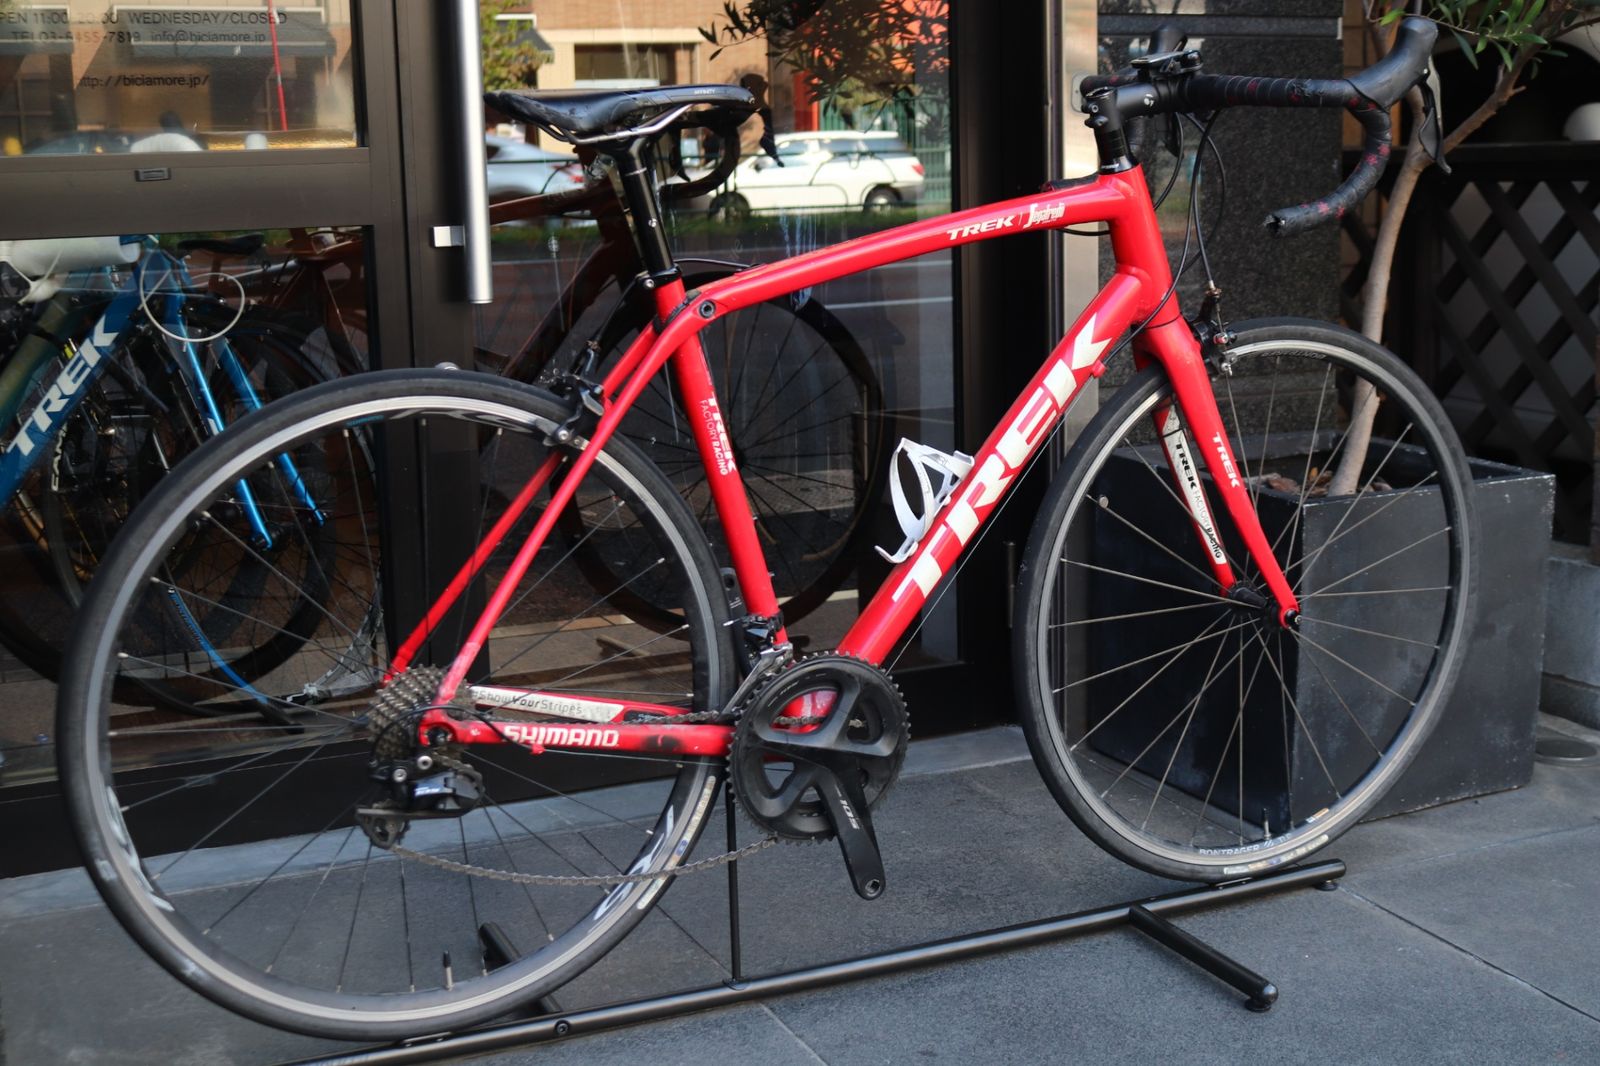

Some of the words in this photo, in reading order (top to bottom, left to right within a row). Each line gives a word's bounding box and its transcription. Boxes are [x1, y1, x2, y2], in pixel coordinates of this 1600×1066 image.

[947, 215, 1015, 240] TREK
[6, 314, 119, 457] TREK
[700, 399, 718, 440] FACTORY
[712, 441, 728, 475] RACING
[892, 312, 1112, 602] TREK
[1212, 431, 1240, 488] TREK
[1176, 443, 1197, 490] TREK
[503, 726, 619, 747] SHIMANO
